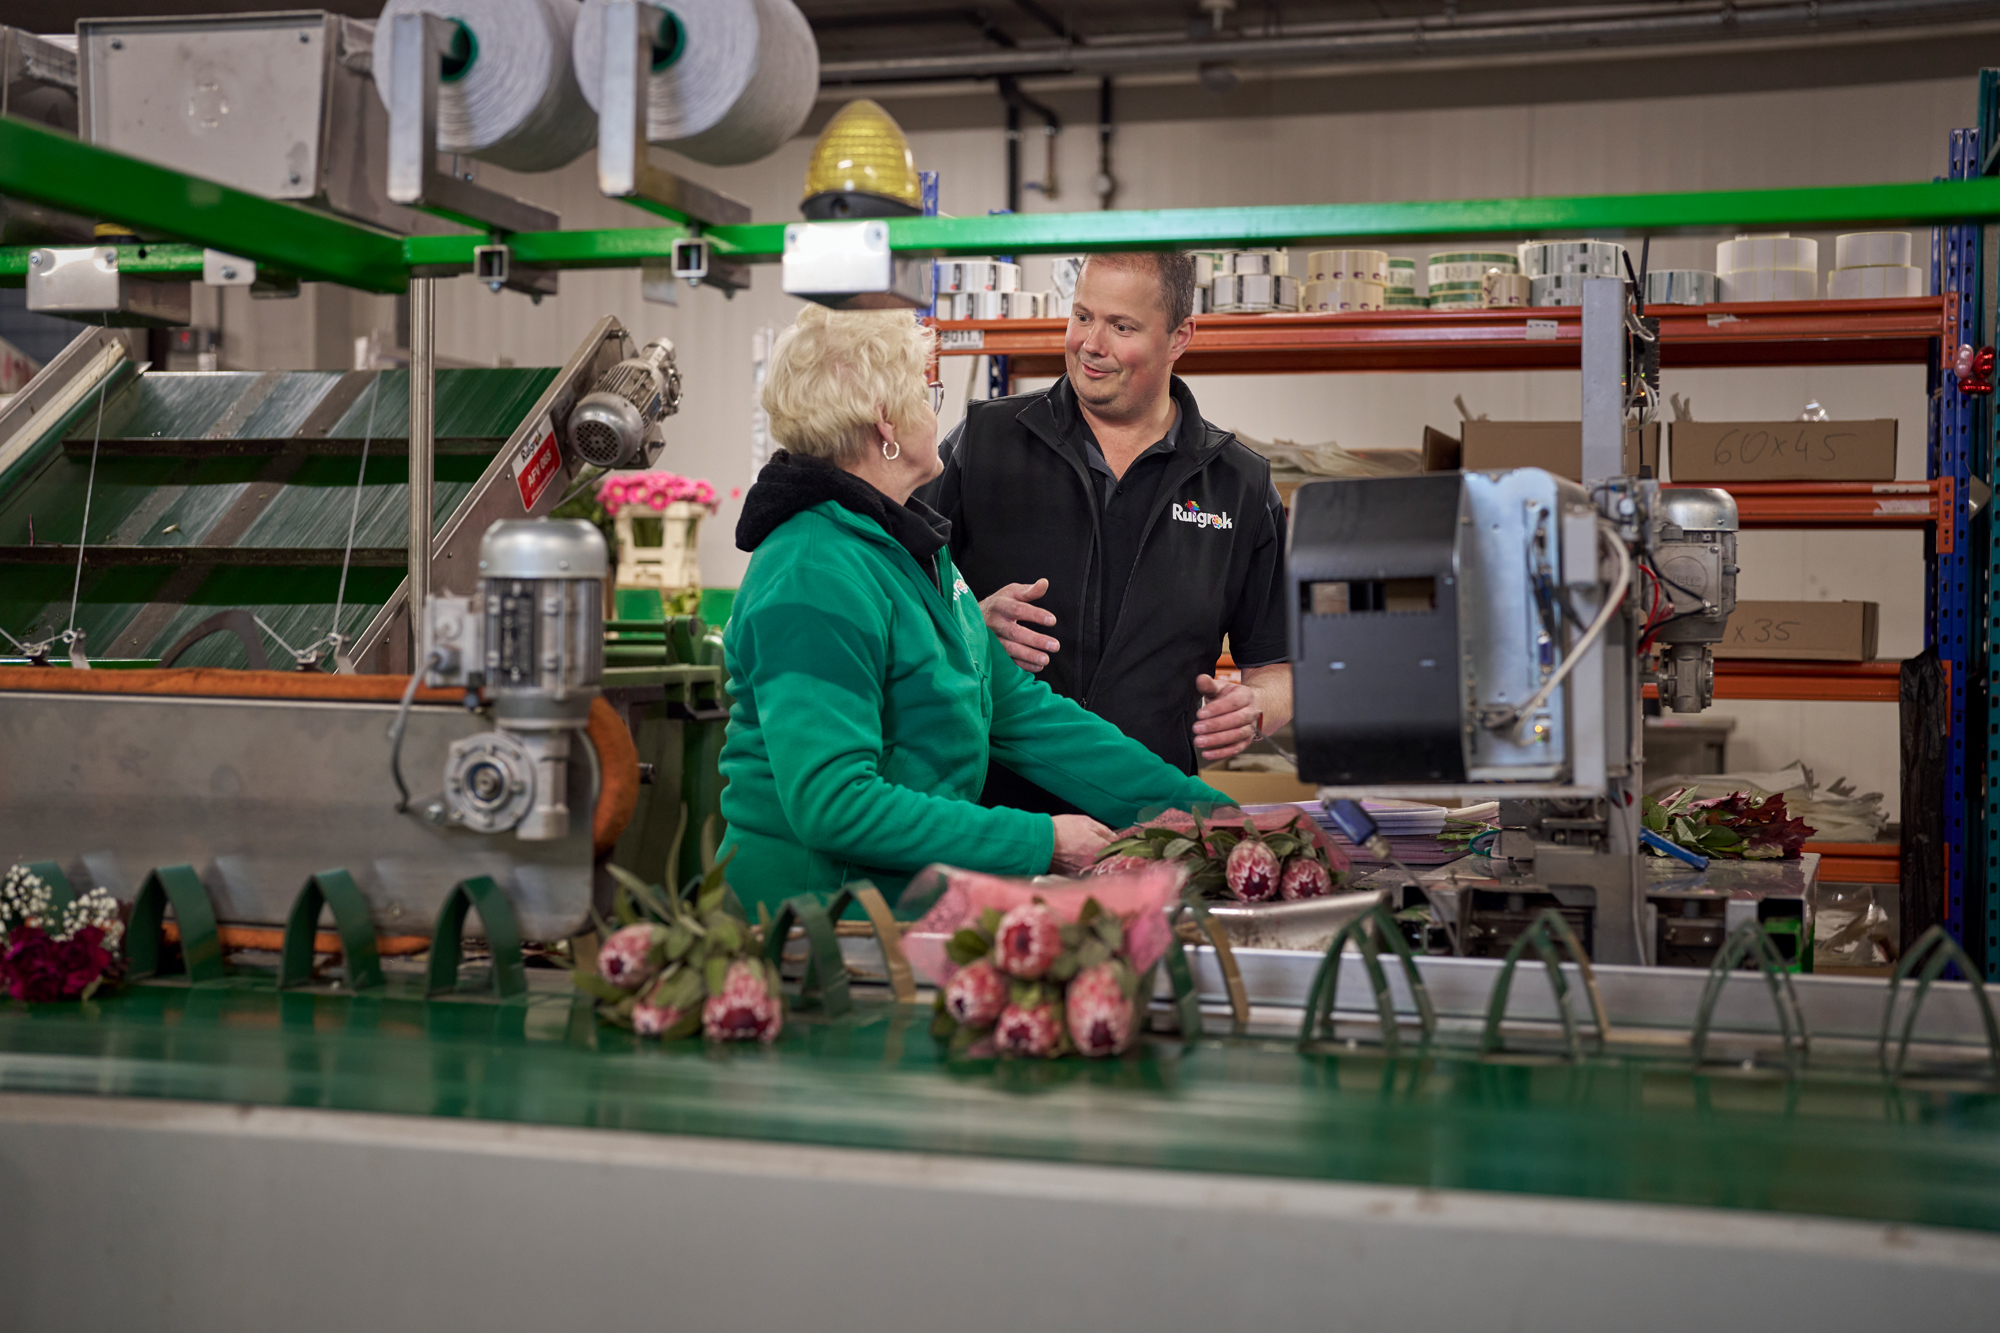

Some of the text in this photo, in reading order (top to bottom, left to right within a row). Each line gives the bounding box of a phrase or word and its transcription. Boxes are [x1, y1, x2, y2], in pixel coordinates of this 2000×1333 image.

[1714, 429, 1857, 466] 60x45
[527, 463, 541, 488] AFV
[1172, 501, 1233, 530] Ruigrok
